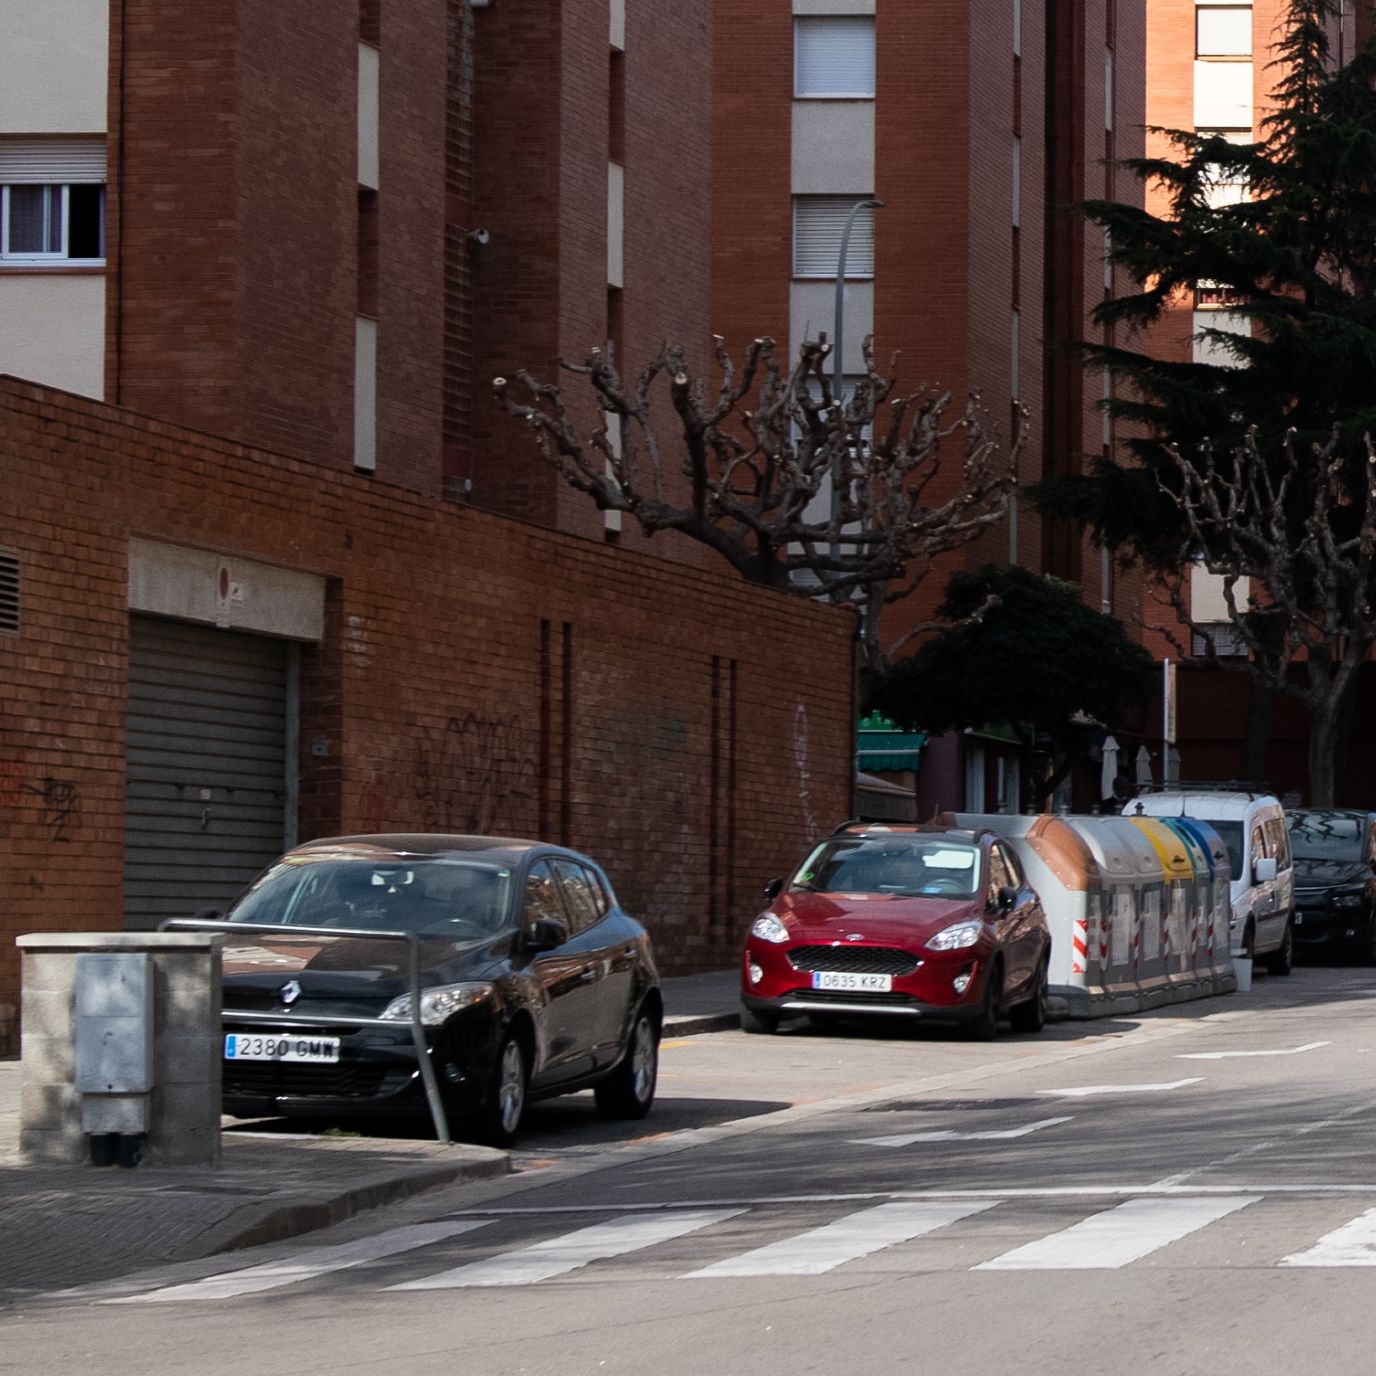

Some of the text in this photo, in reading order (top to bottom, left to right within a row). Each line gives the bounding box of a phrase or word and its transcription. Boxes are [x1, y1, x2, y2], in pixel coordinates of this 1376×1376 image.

[823, 974, 886, 989] 0635 KRZ
[240, 1038, 334, 1058] 2380 GMW
